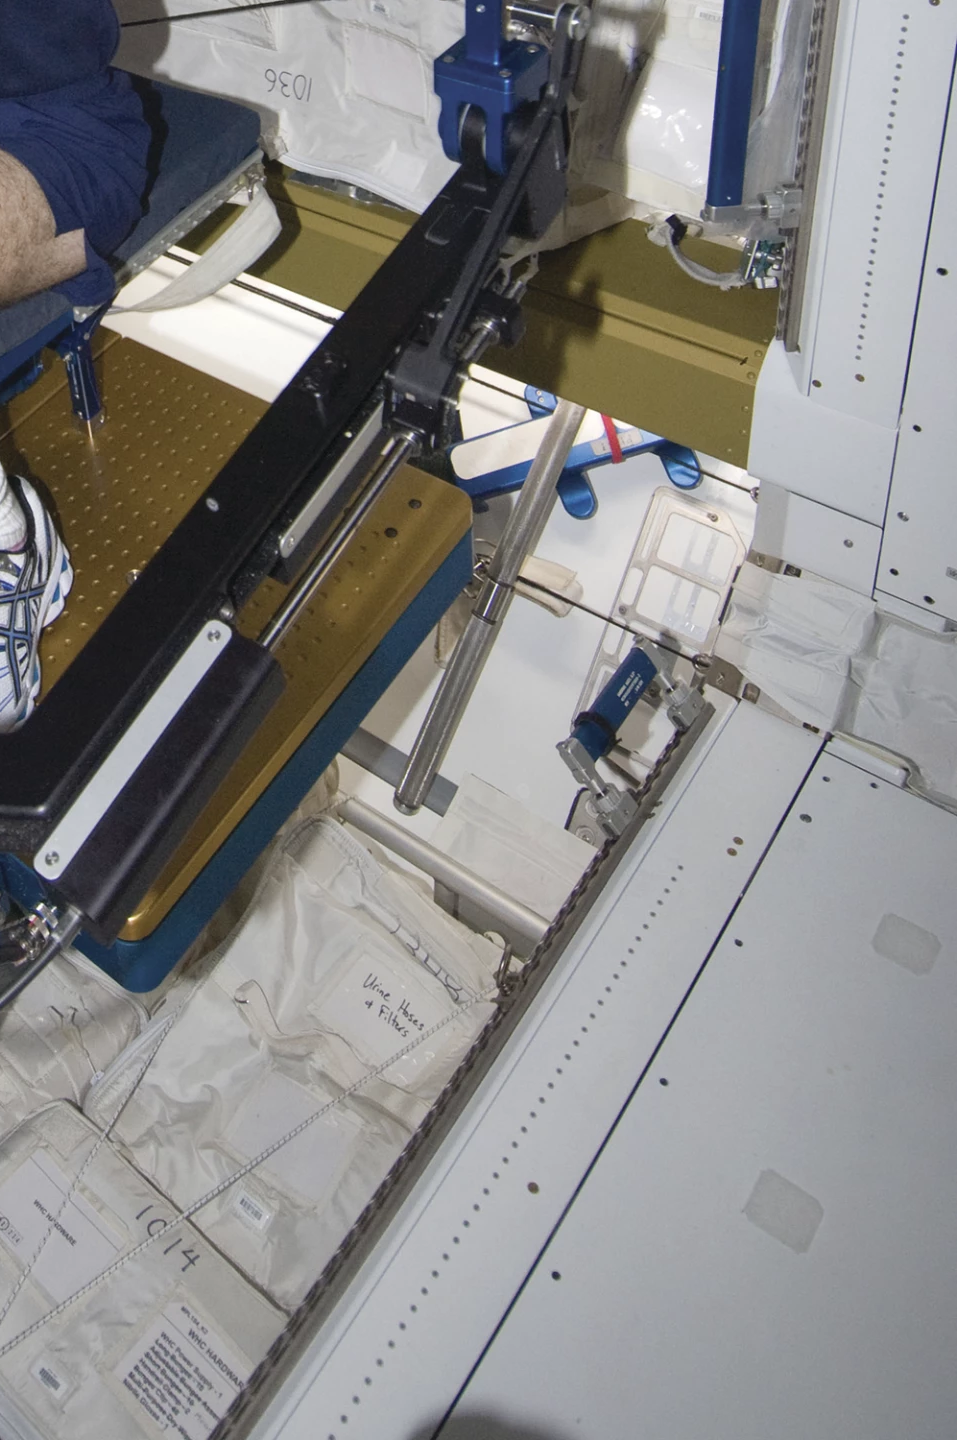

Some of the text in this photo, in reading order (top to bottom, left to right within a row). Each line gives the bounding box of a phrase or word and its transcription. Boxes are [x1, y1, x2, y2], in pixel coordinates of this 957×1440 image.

[264, 68, 313, 102] 1036
[363, 973, 425, 1031] Urine Hoses
[378, 1004, 409, 1037] Filters
[33, 1199, 47, 1215] WHC
[188, 1328, 207, 1350] WHC
[144, 1351, 161, 1370] Short
[160, 1368, 182, 1393] Bungee
[155, 1338, 170, 1357] Long
[170, 1354, 192, 1378] Bungee
[160, 1331, 176, 1349] WHC
[175, 1347, 193, 1368] Power
[193, 1366, 214, 1391] Supply
[179, 1376, 202, 1402] Bungee
